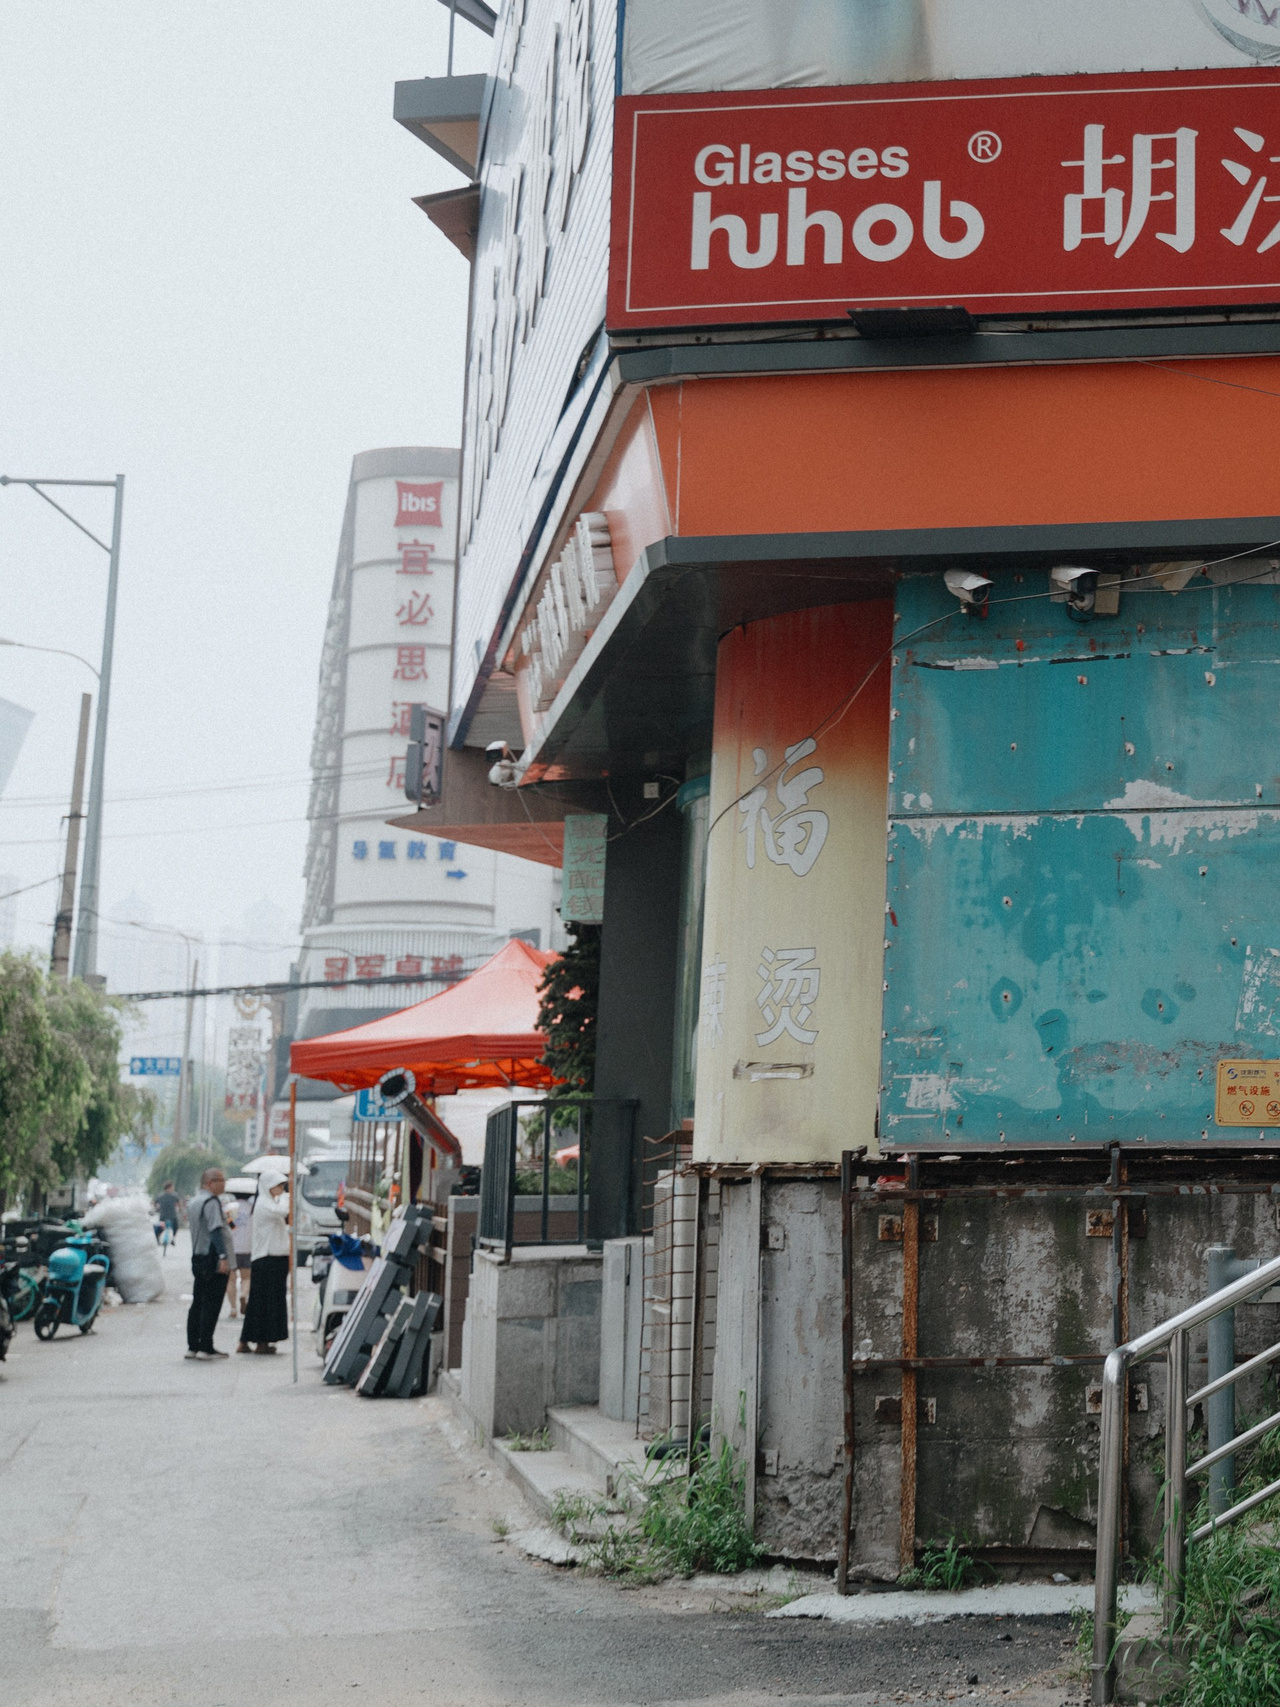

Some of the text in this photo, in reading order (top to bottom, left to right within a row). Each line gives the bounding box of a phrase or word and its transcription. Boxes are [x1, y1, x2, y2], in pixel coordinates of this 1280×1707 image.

[694, 143, 911, 187] Glasses
[690, 181, 986, 270] huhob
[400, 492, 437, 513] ibis
[1226, 1085, 1271, 1096] 燃气设施
